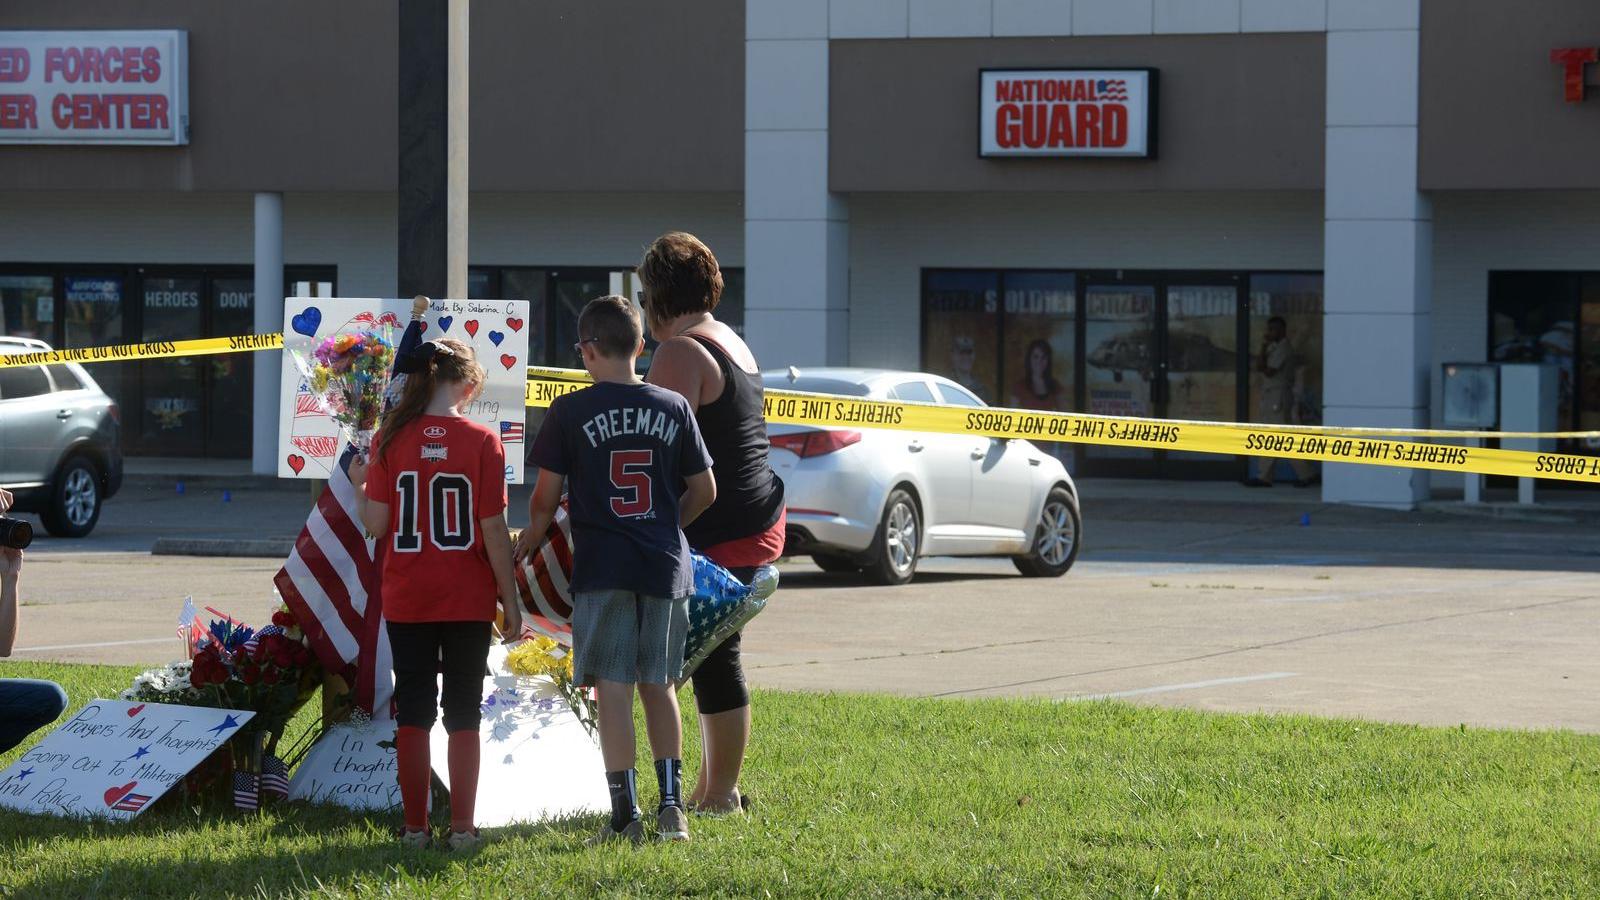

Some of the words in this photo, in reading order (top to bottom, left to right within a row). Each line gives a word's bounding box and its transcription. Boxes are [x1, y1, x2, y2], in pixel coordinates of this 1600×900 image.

[44, 46, 162, 84] FORCES
[995, 79, 1097, 102] NATIONAL
[52, 93, 169, 130] CENTER
[995, 103, 1128, 149] GUARD
[145, 291, 198, 307] HEROES
[468, 302, 498, 313] Sabrina
[63, 348, 90, 361] LINE
[92, 346, 108, 359] DO
[111, 344, 133, 358] NOT
[137, 341, 176, 356] CROSS
[777, 398, 796, 418] DO
[800, 400, 831, 420] LINE
[835, 402, 904, 425] SHERIFF'S
[582, 407, 680, 448] FREEMAN
[965, 412, 1012, 432] CROSS
[1015, 415, 1045, 434] NOT
[1050, 418, 1069, 436] DO
[1072, 420, 1104, 439] LINE
[1108, 422, 1180, 443] SHERIFF'S
[1245, 433, 1295, 452] CROSS
[1297, 437, 1328, 454] NOT
[1331, 439, 1353, 456] DO
[1355, 441, 1390, 459] LINE
[1393, 444, 1468, 465] SHERIFF'S
[1535, 455, 1586, 475] CROSS
[609, 449, 653, 518] 5
[394, 471, 474, 553] 10
[61, 705, 118, 739] Prayers
[119, 717, 159, 740] And
[156, 719, 219, 755] Thoughts
[341, 734, 364, 753] In
[20, 745, 71, 772] Going
[107, 760, 128, 776] To
[0, 775, 31, 797] And
[32, 777, 82, 808] Police
